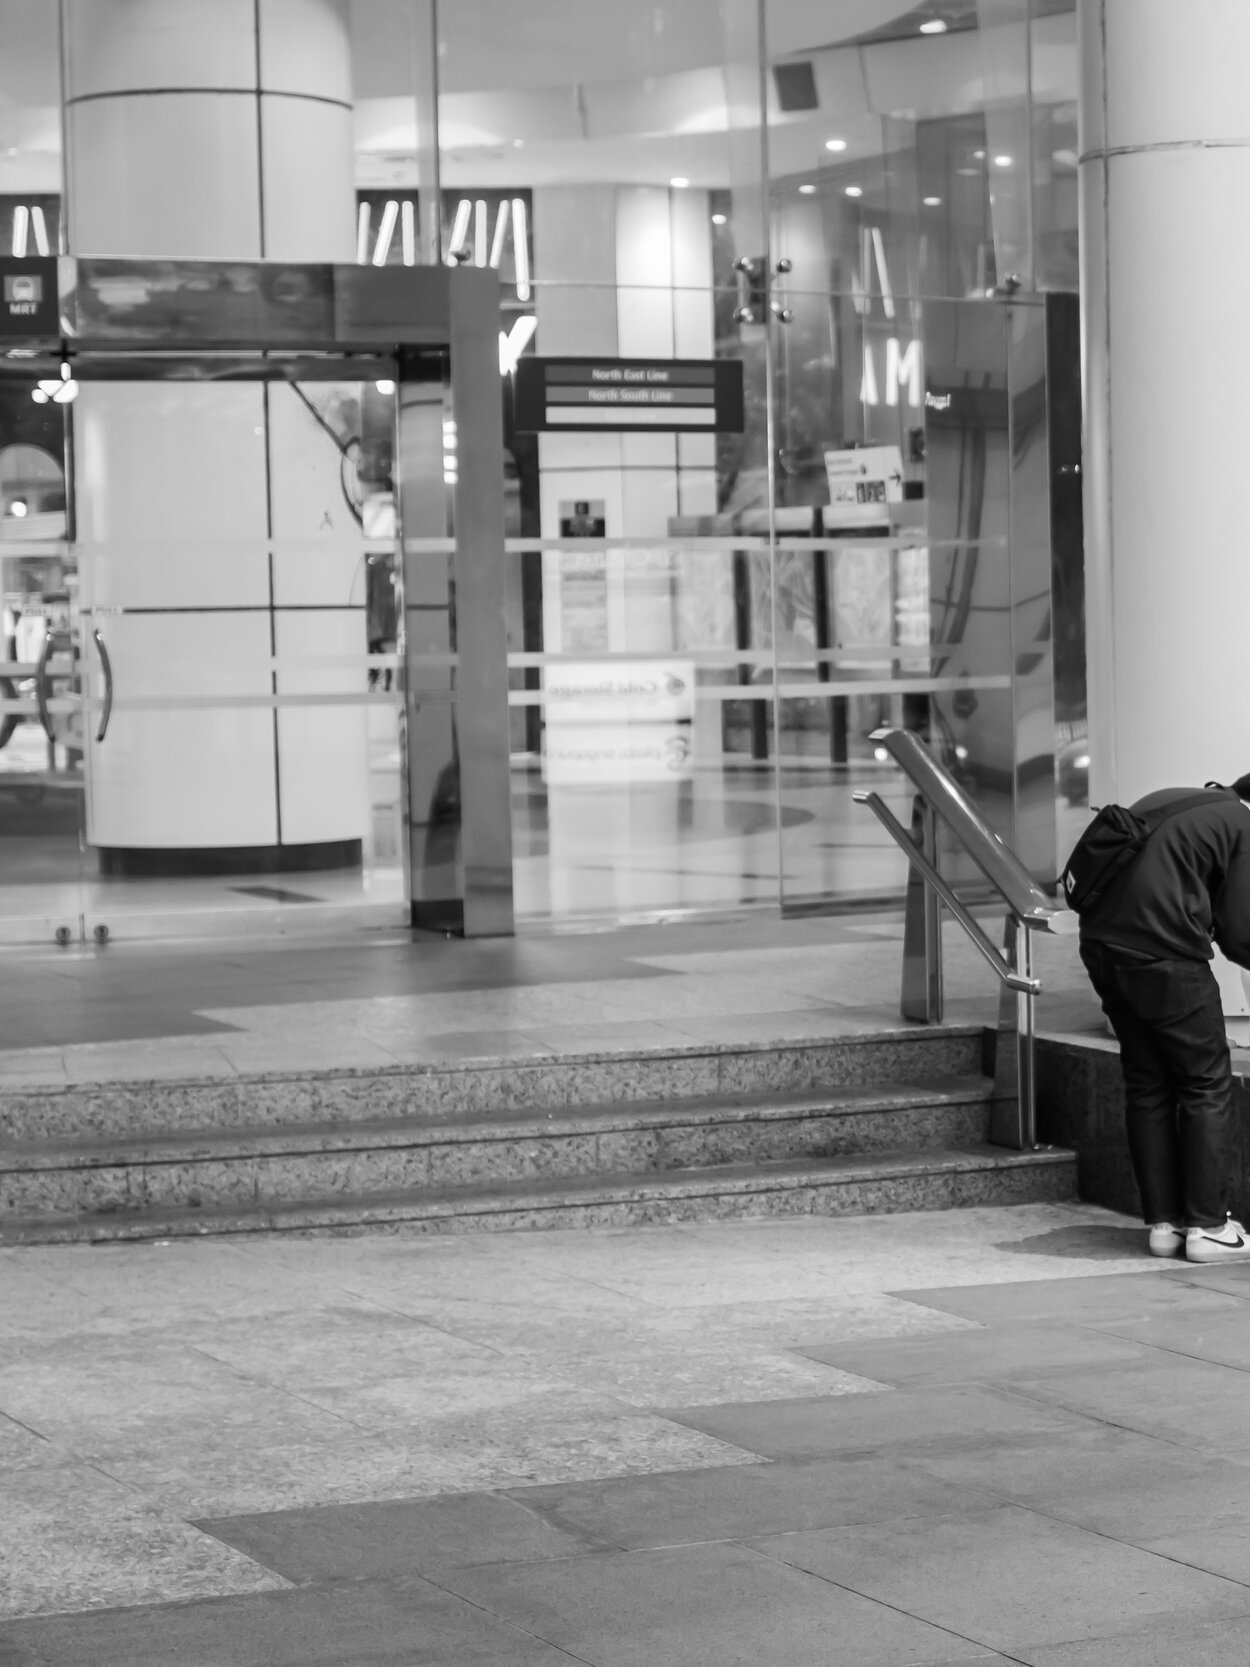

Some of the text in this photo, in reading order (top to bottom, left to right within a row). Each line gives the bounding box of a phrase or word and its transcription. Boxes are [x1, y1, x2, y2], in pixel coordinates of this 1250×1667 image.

[9, 302, 37, 315] MRT
[592, 369, 669, 382] North East Line
[588, 389, 673, 402] North South Line
